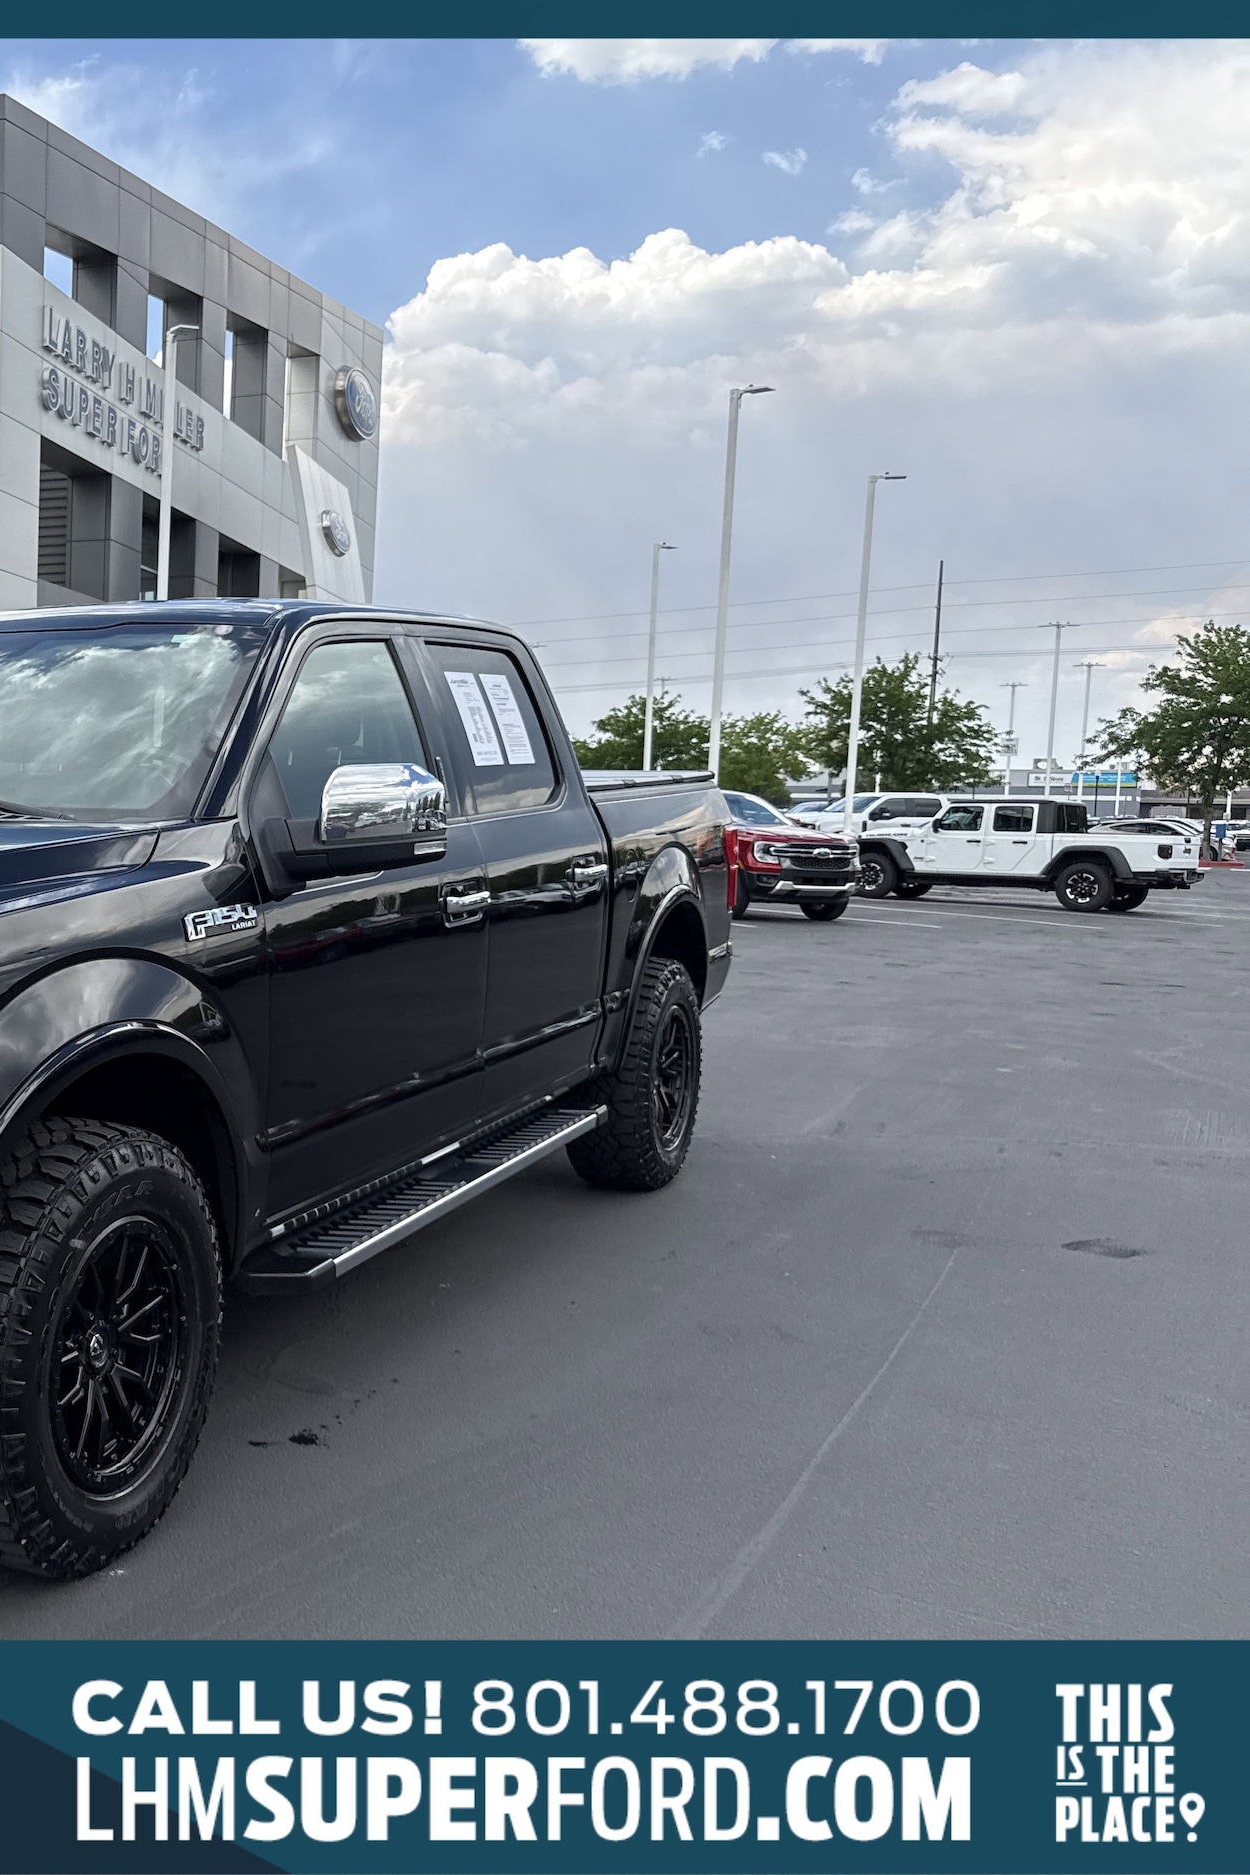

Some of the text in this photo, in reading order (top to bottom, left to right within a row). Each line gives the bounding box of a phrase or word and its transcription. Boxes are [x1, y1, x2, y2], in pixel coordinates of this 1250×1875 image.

[42, 367, 163, 477] SUPER FOR
[43, 305, 205, 452] LARRY H MILER
[231, 919, 256, 930] LARIAT
